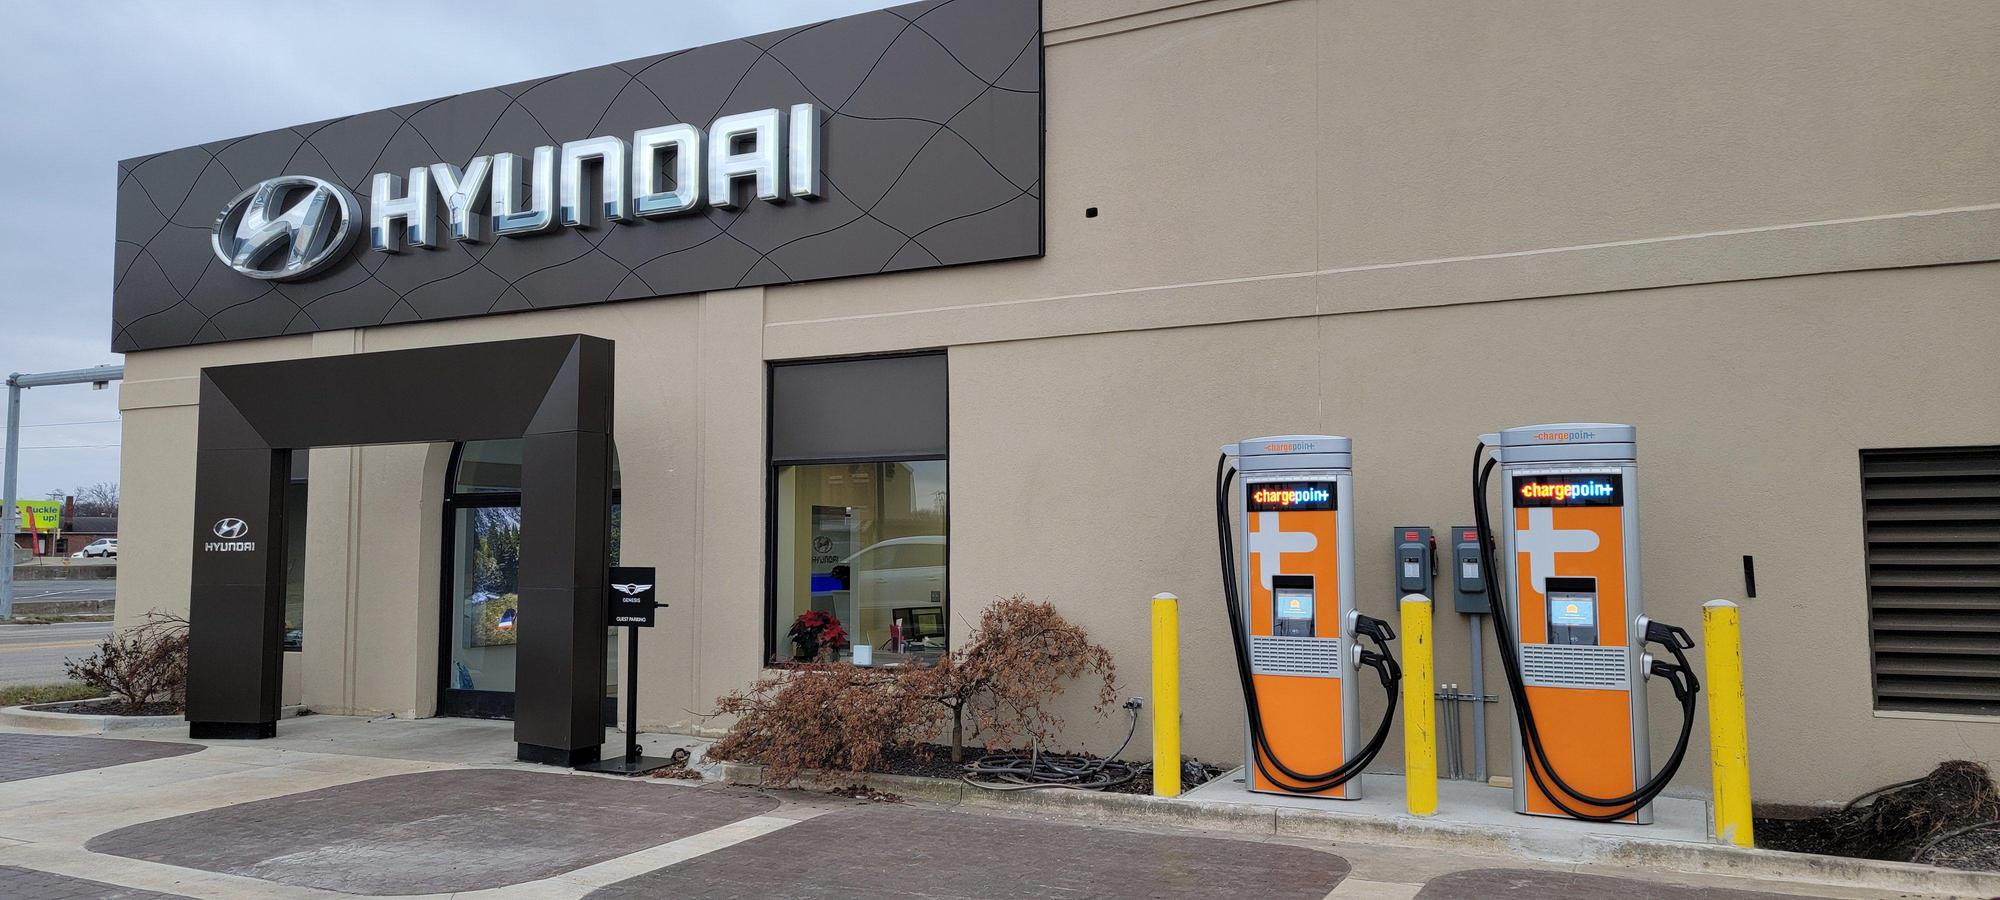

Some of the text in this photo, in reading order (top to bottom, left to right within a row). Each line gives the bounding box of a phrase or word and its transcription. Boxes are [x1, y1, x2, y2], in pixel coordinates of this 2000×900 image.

[369, 103, 823, 252] HYUNDAI
[1254, 487, 1329, 504] chargepoint
[1521, 480, 1614, 500] chargepoint
[205, 542, 255, 552] HYUNDAI
